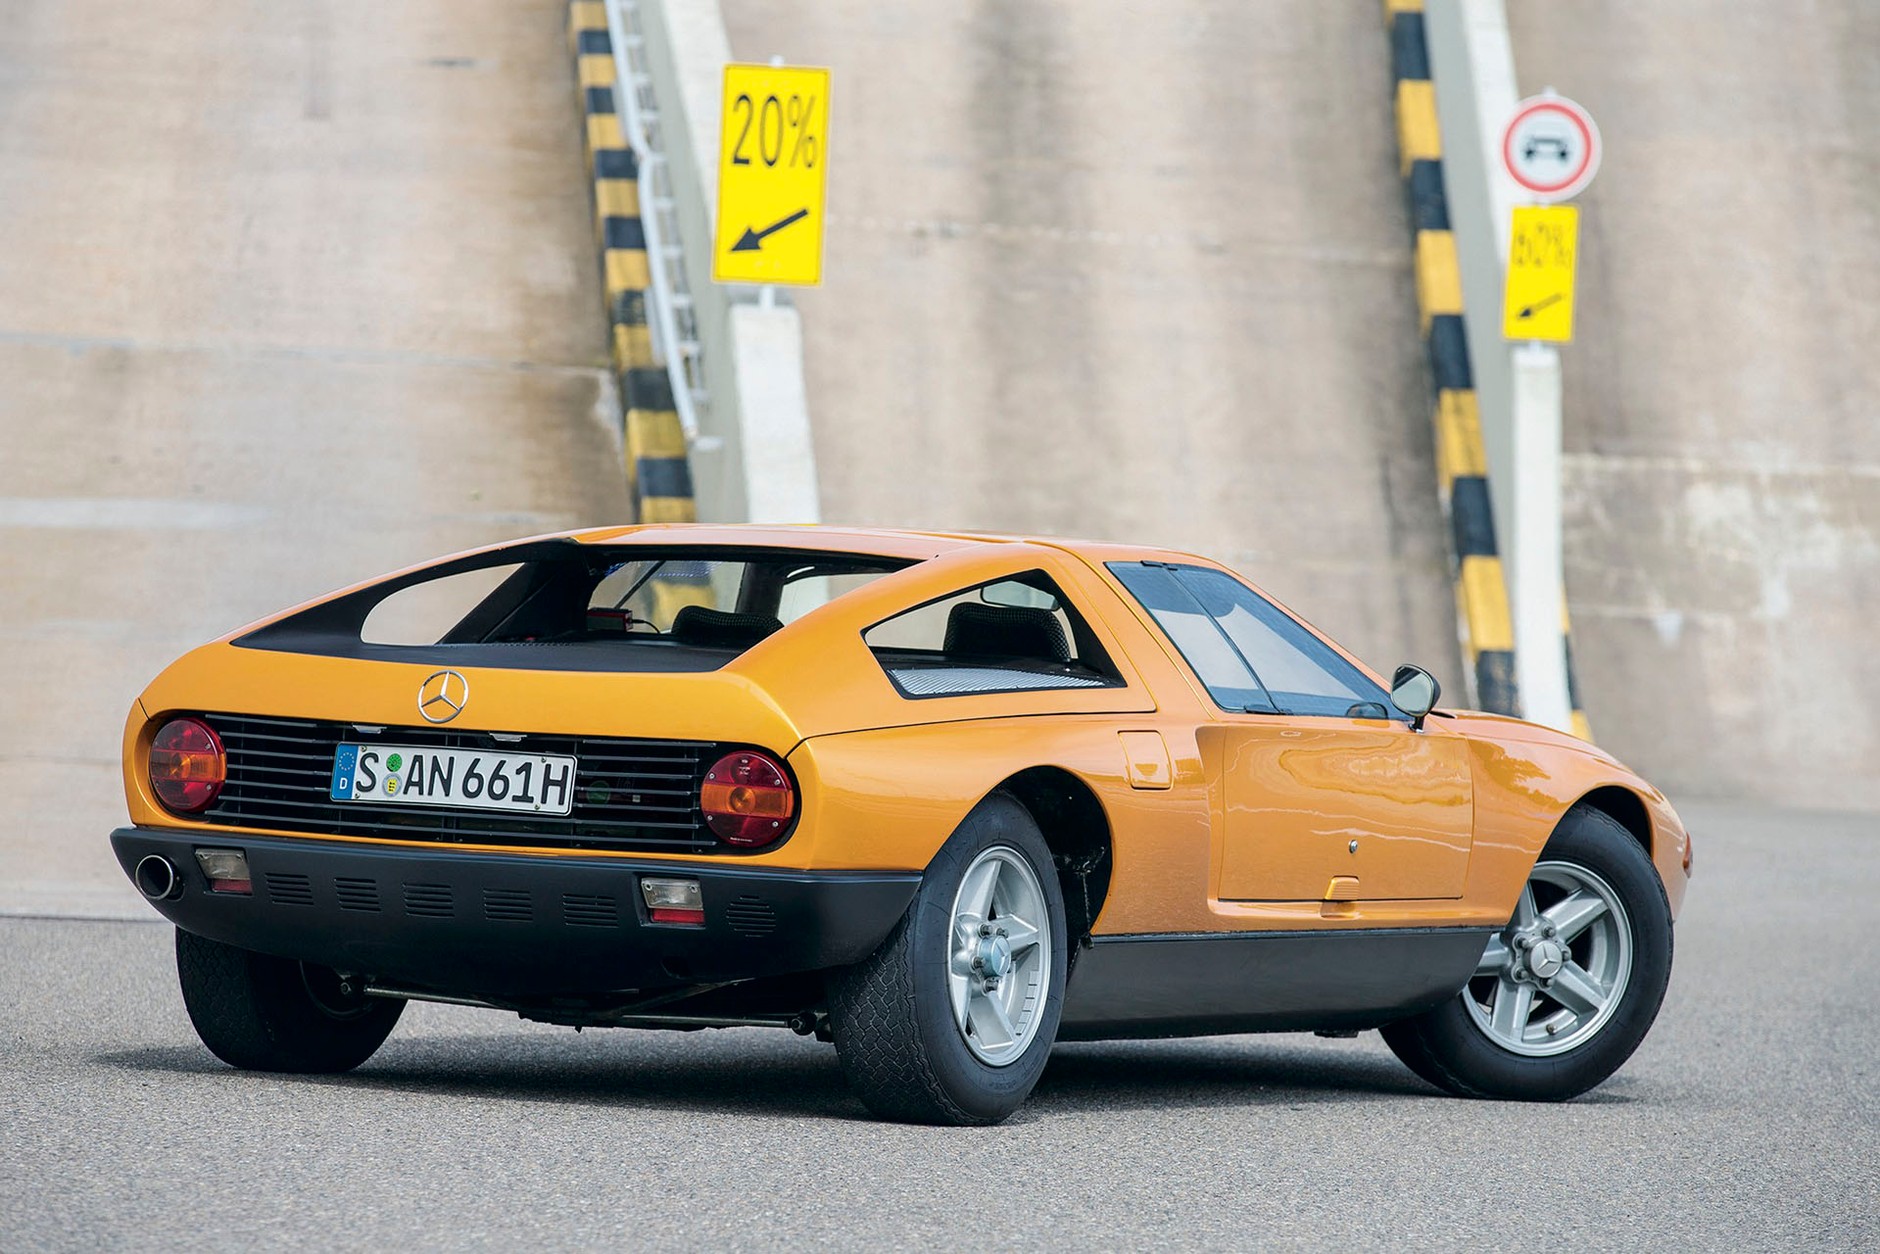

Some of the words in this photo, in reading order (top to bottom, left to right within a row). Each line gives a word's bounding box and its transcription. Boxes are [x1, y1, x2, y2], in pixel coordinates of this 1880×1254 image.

[732, 94, 818, 168] 20%
[339, 777, 348, 790] D
[355, 752, 379, 793] S
[403, 754, 455, 797] AN
[462, 757, 570, 806] 661H
